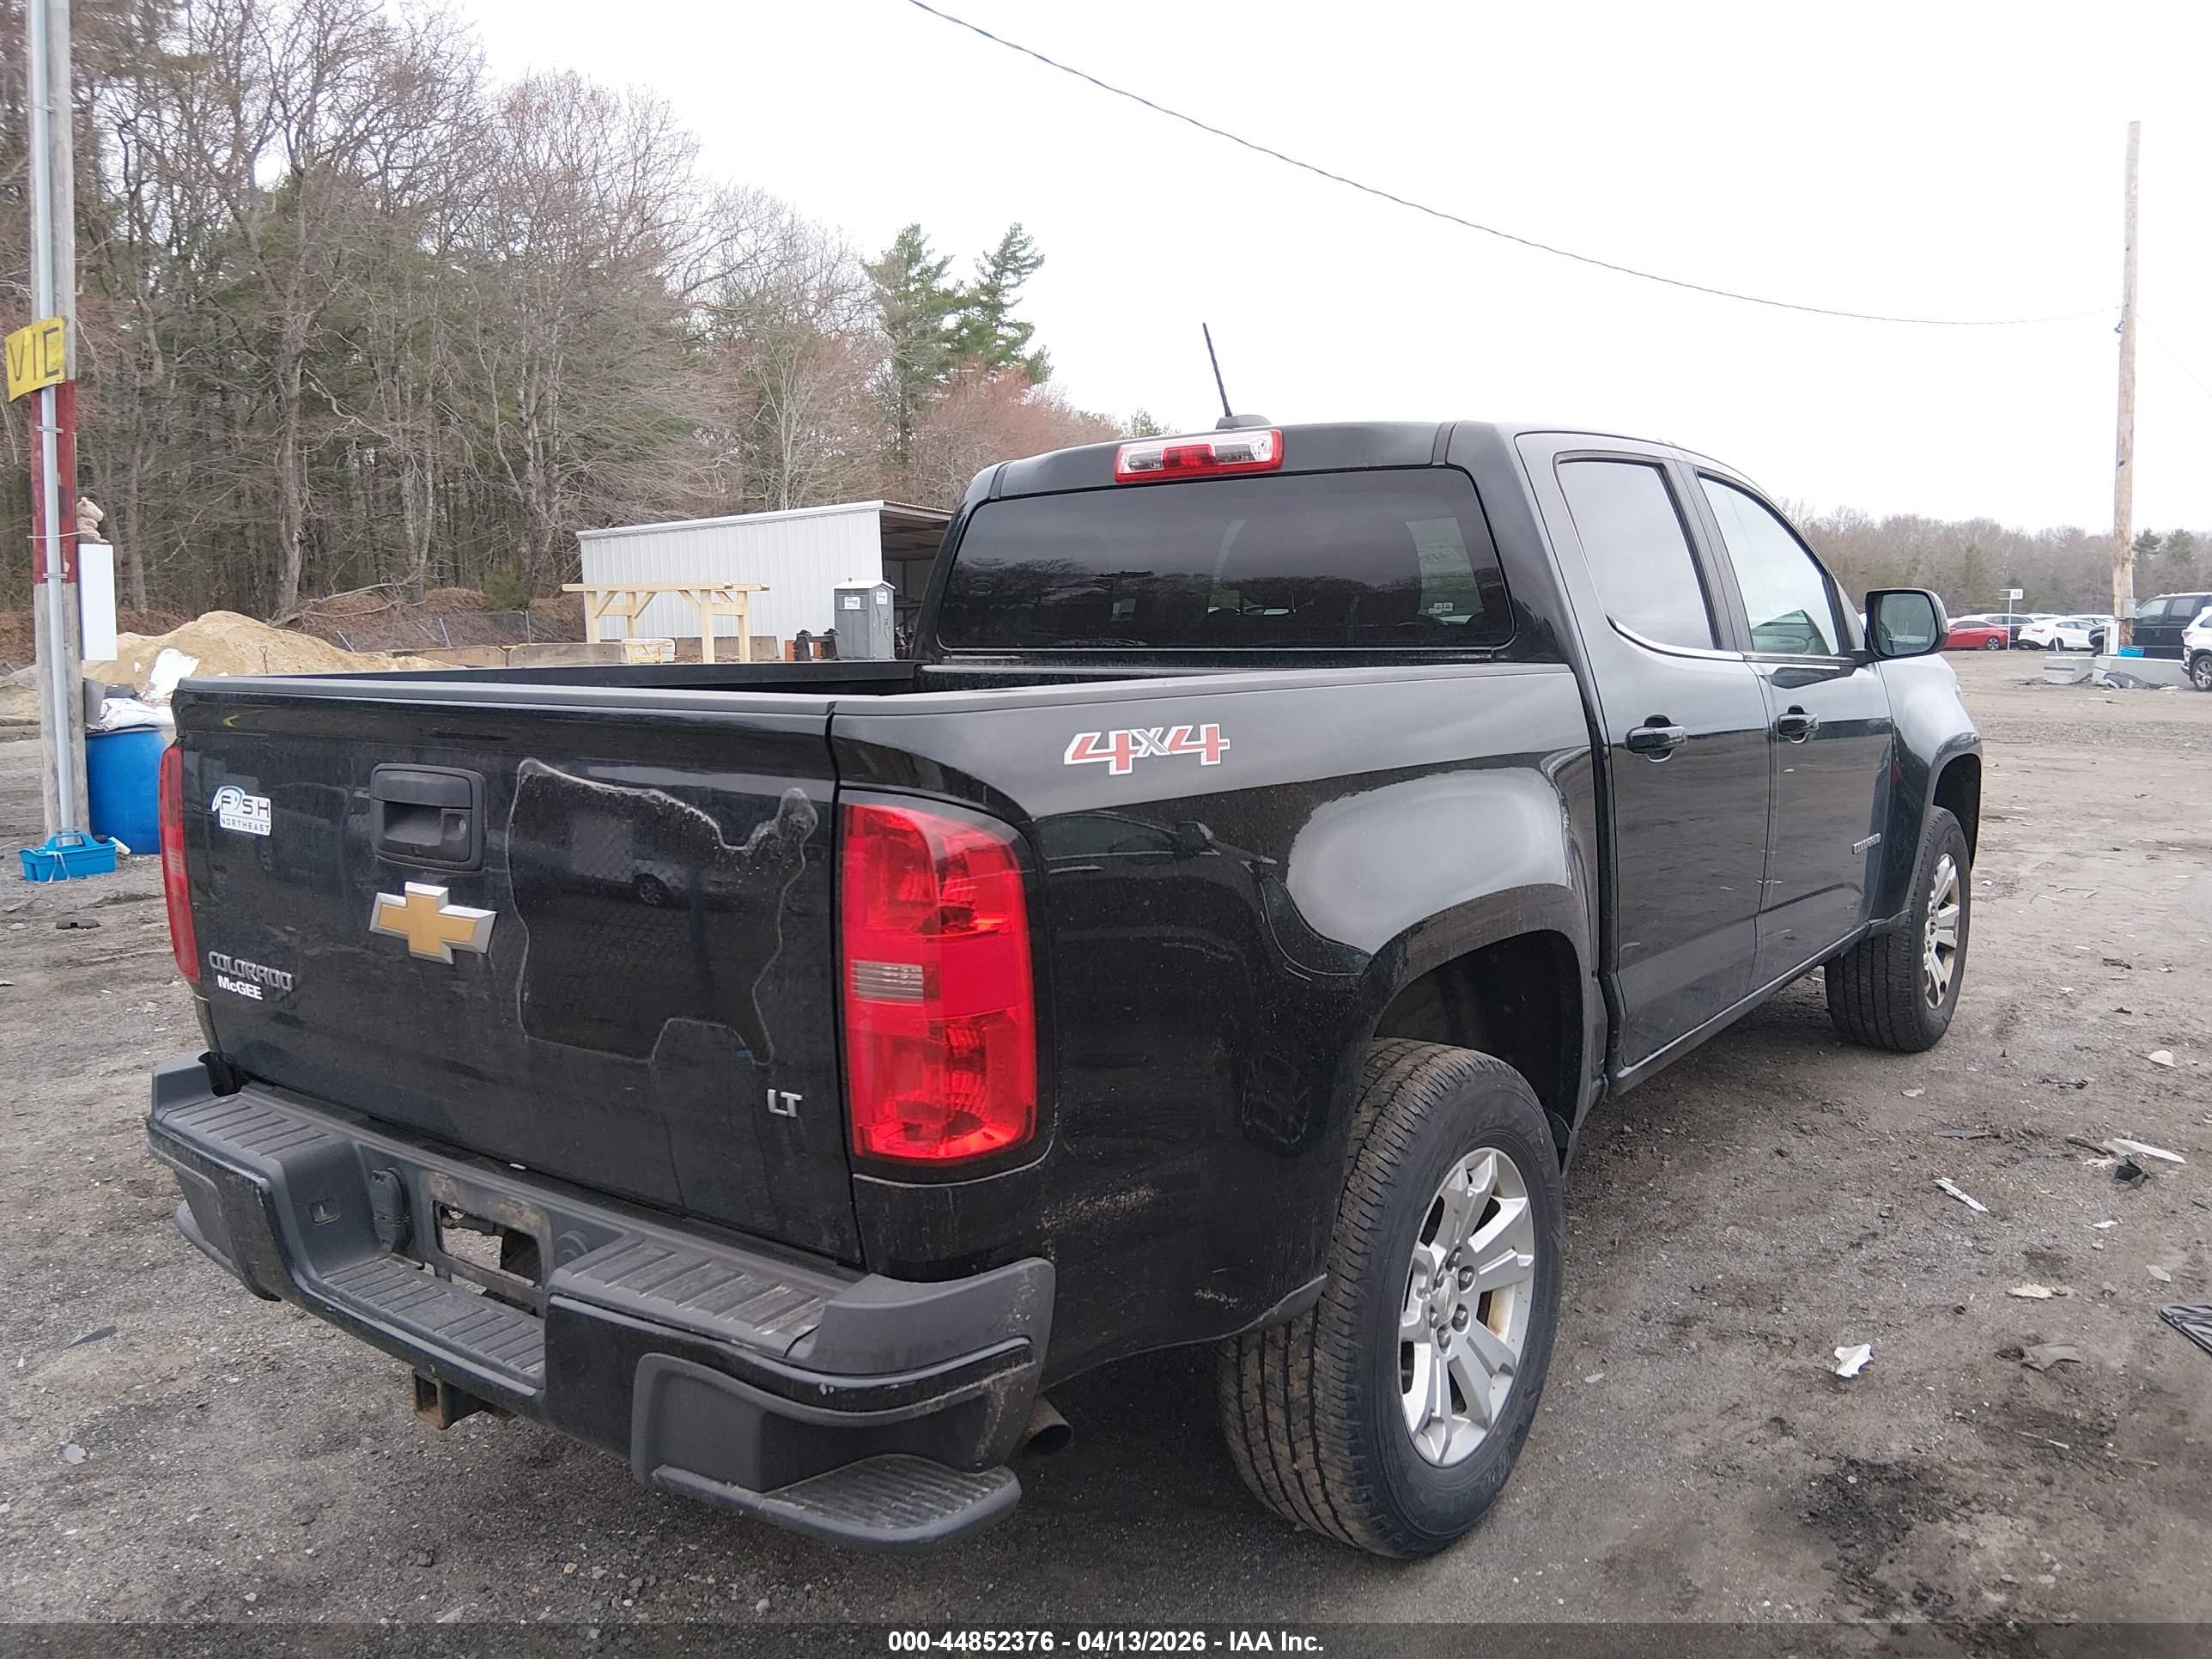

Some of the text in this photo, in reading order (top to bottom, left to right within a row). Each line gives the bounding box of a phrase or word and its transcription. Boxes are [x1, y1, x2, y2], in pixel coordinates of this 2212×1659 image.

[9, 326, 59, 382] VIC
[222, 817, 270, 833] NORTHEAST
[209, 951, 293, 992] COLORADO
[217, 975, 263, 1000] McGEE
[767, 1089, 802, 1118] LT
